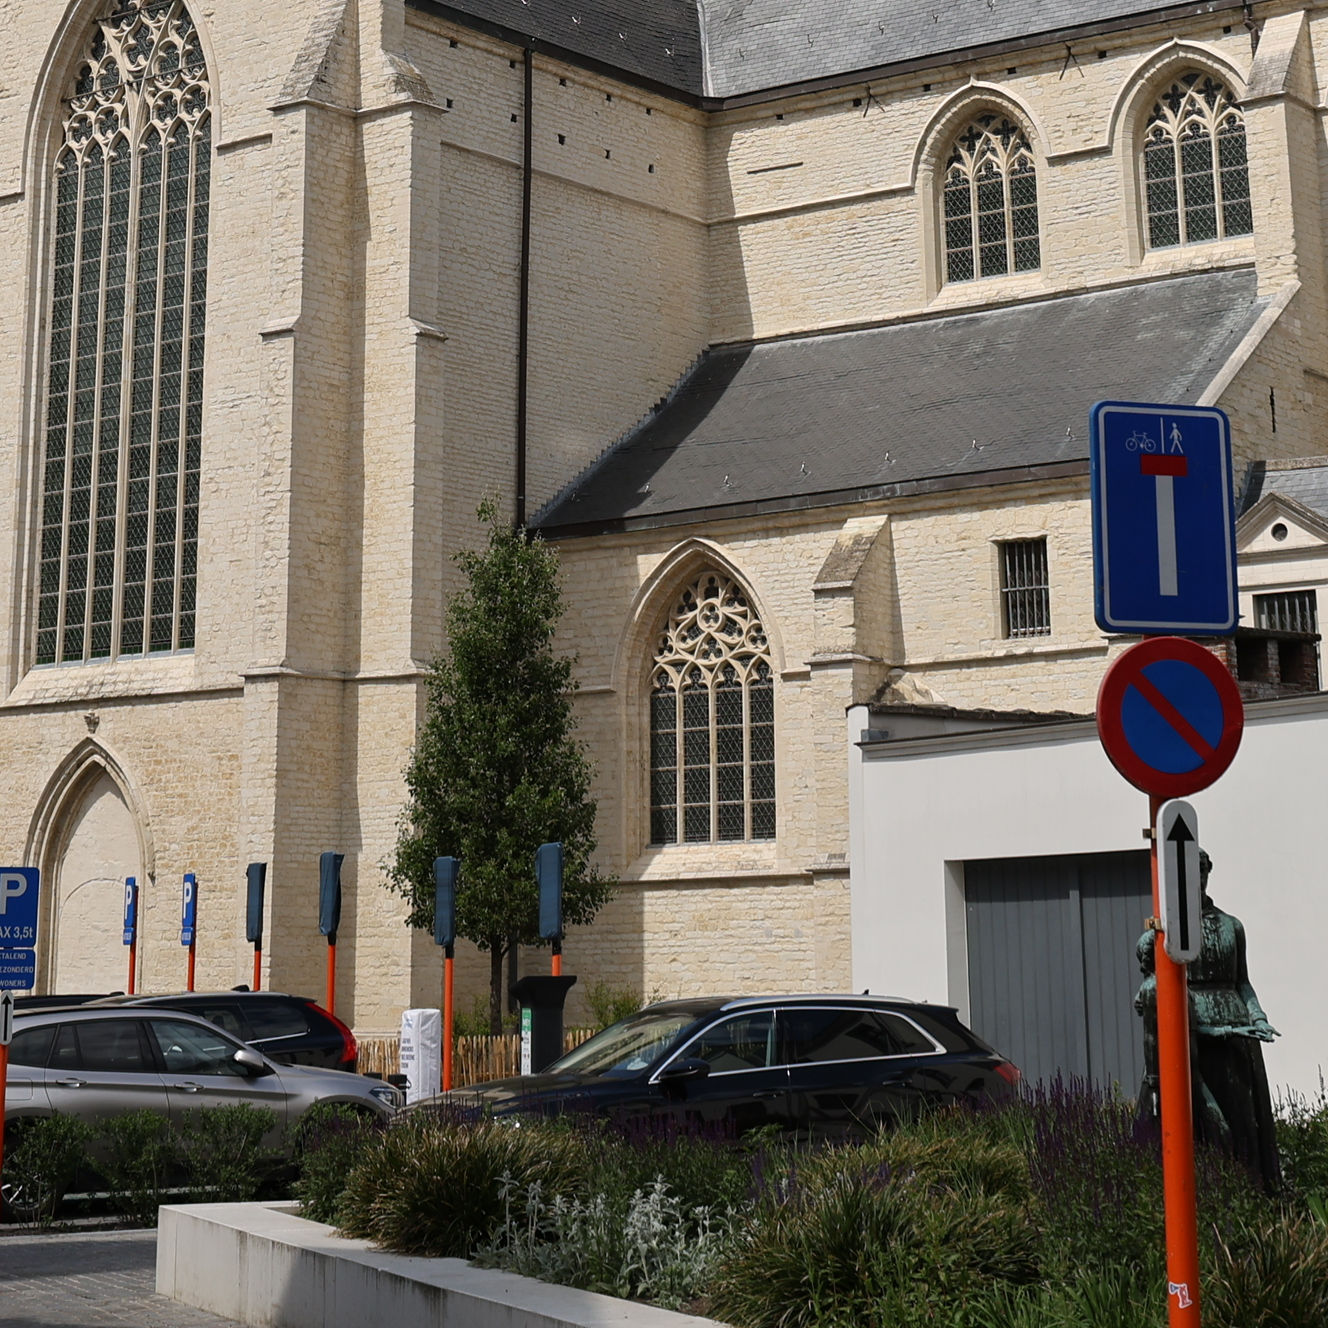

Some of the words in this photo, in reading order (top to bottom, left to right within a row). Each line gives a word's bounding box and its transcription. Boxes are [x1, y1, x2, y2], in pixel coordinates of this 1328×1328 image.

[124, 885, 132, 920] P
[182, 881, 192, 919] P
[13, 925, 33, 940] 3,5t
